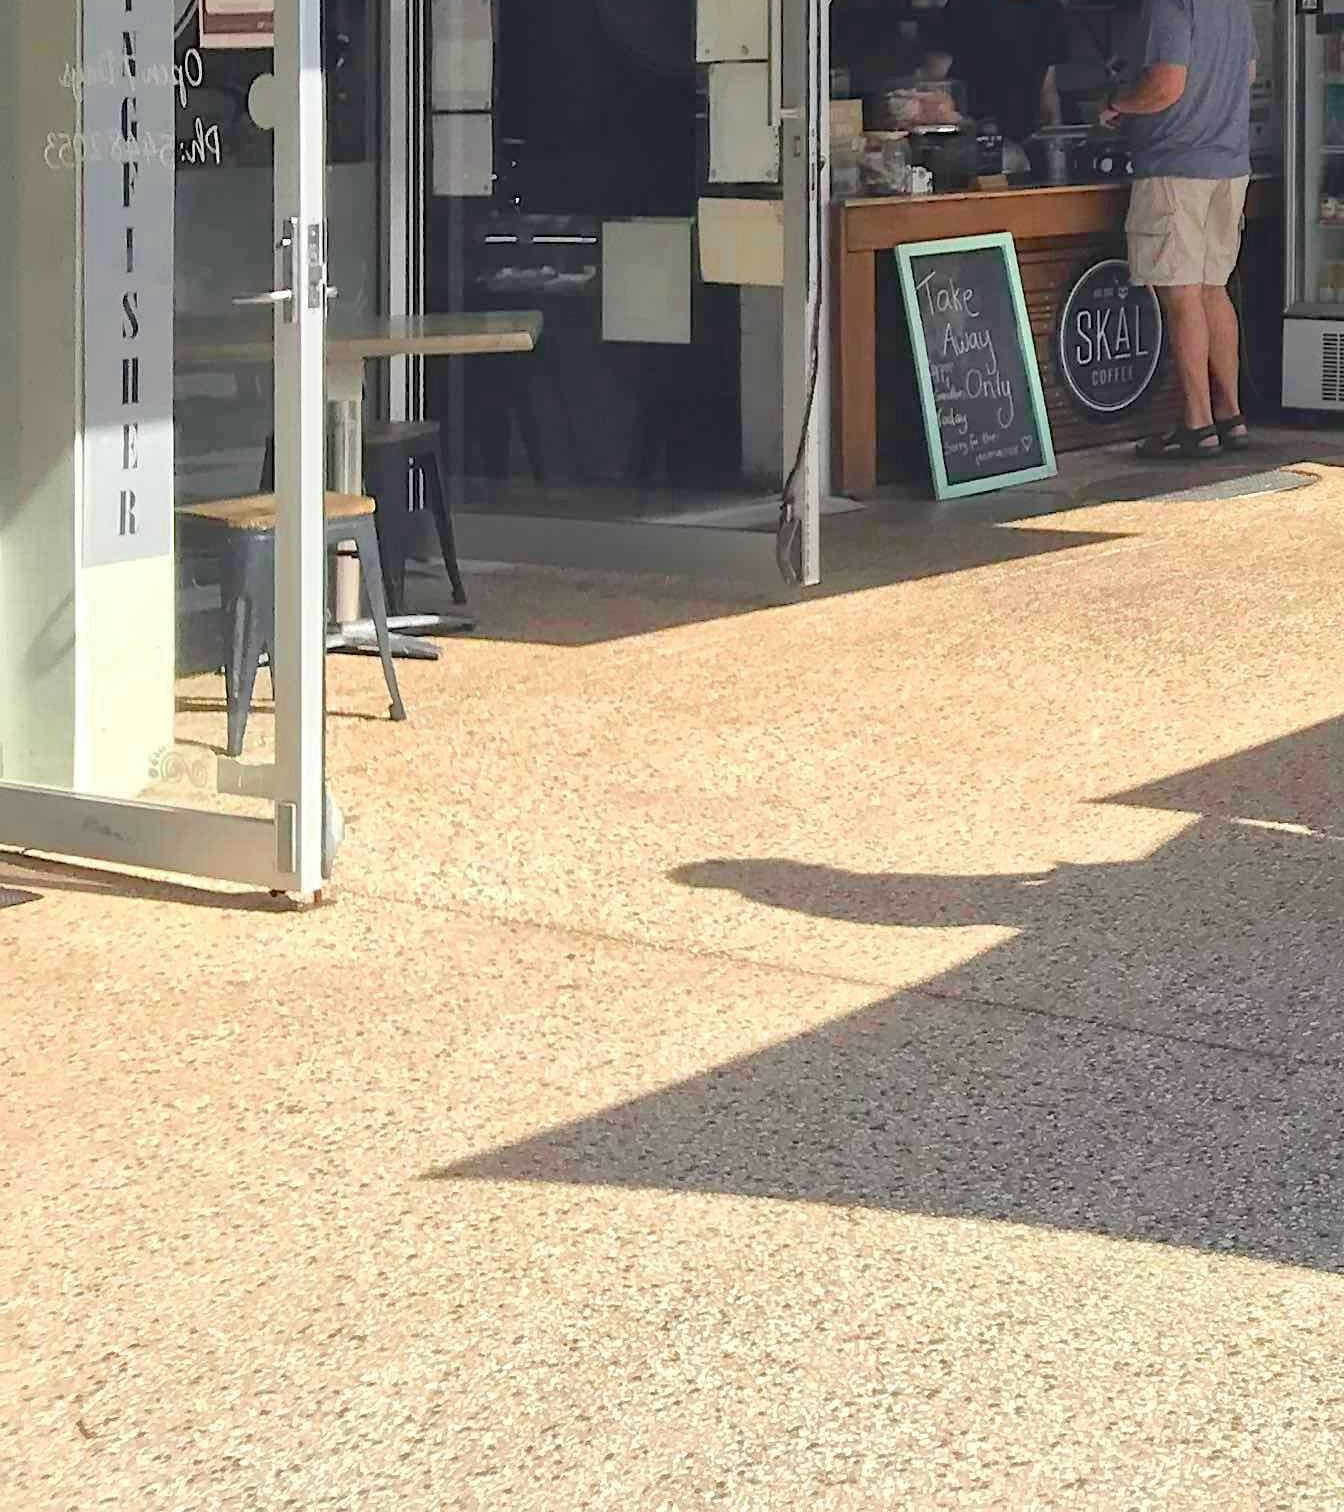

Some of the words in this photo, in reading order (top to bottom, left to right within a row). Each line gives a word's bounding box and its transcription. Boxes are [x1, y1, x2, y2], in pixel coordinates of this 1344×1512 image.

[914, 271, 981, 318] Take
[943, 322, 998, 376] Away
[965, 368, 1015, 430] Only
[1091, 366, 1134, 386] COFFEE
